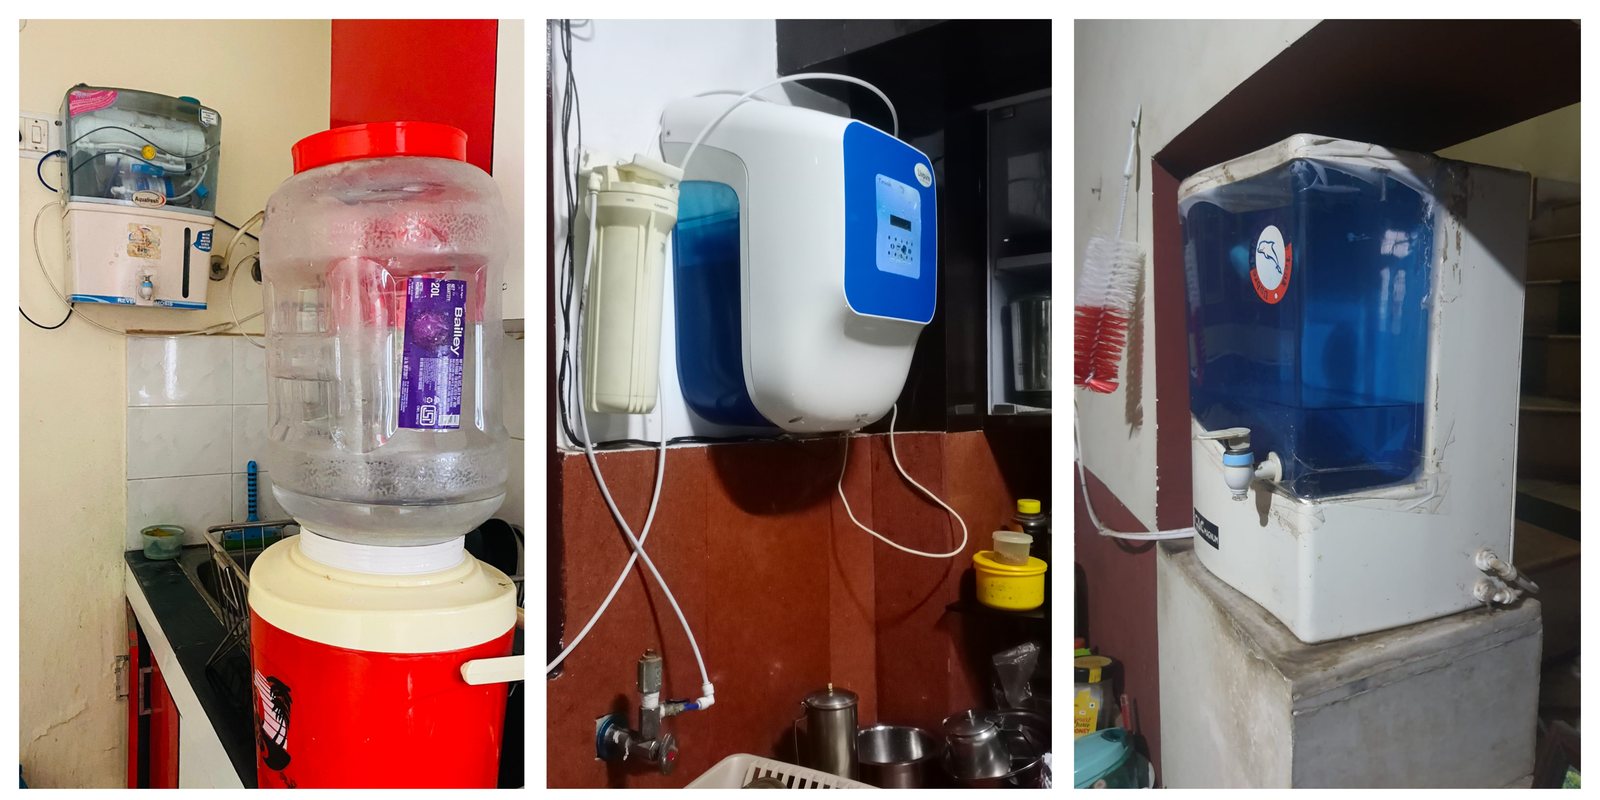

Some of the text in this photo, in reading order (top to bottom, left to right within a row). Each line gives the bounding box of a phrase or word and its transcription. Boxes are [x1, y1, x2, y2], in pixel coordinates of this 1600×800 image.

[135, 196, 159, 204] Aquafresh
[430, 282, 440, 298] 20L
[450, 307, 463, 357] Bailley
